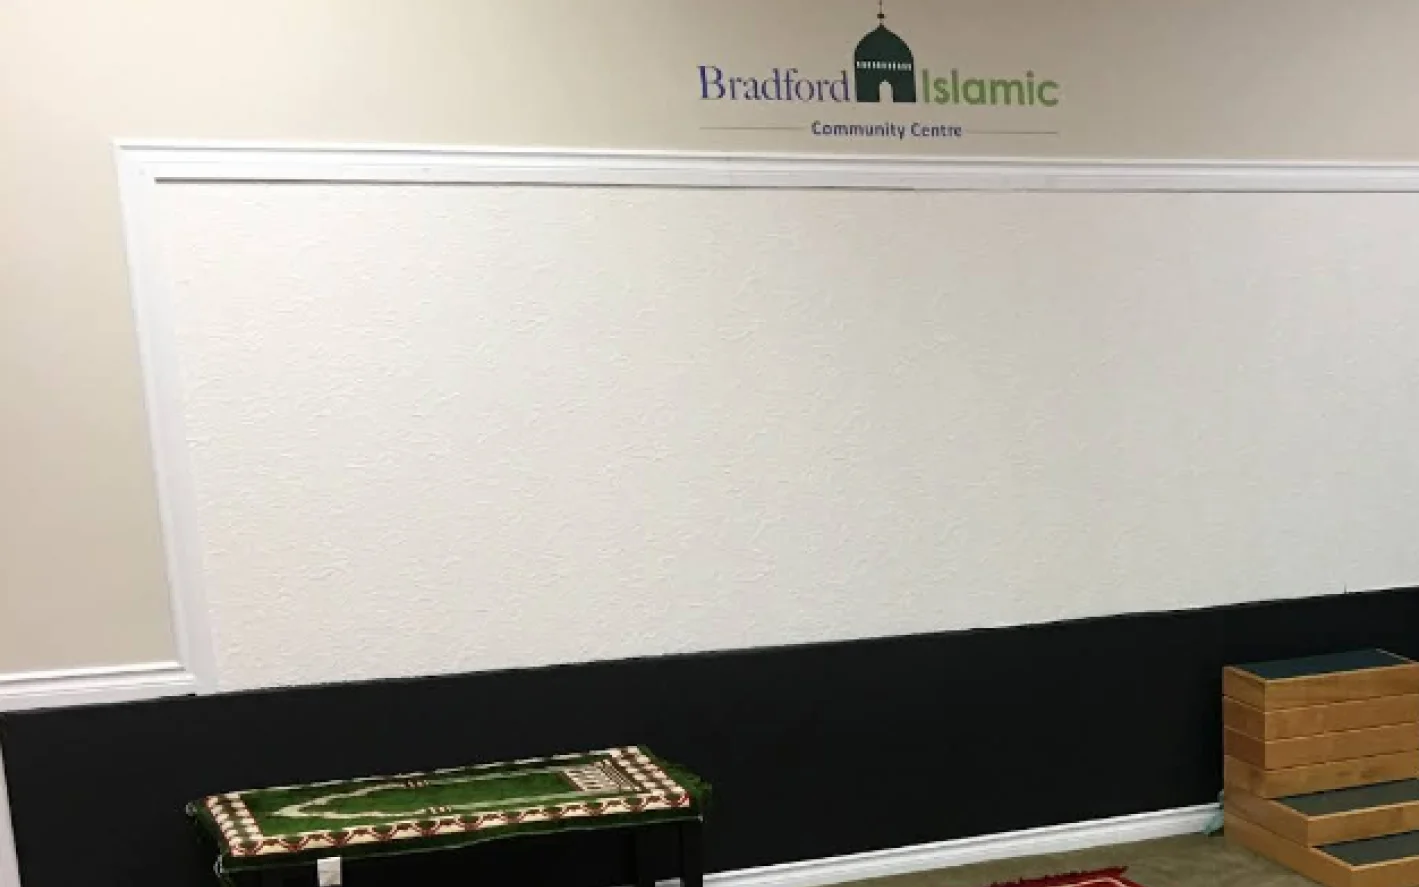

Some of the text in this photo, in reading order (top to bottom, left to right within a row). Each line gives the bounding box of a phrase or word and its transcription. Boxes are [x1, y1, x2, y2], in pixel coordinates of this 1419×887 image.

[697, 65, 1060, 107] Bradford Islamic
[811, 120, 963, 139] Community Centre
